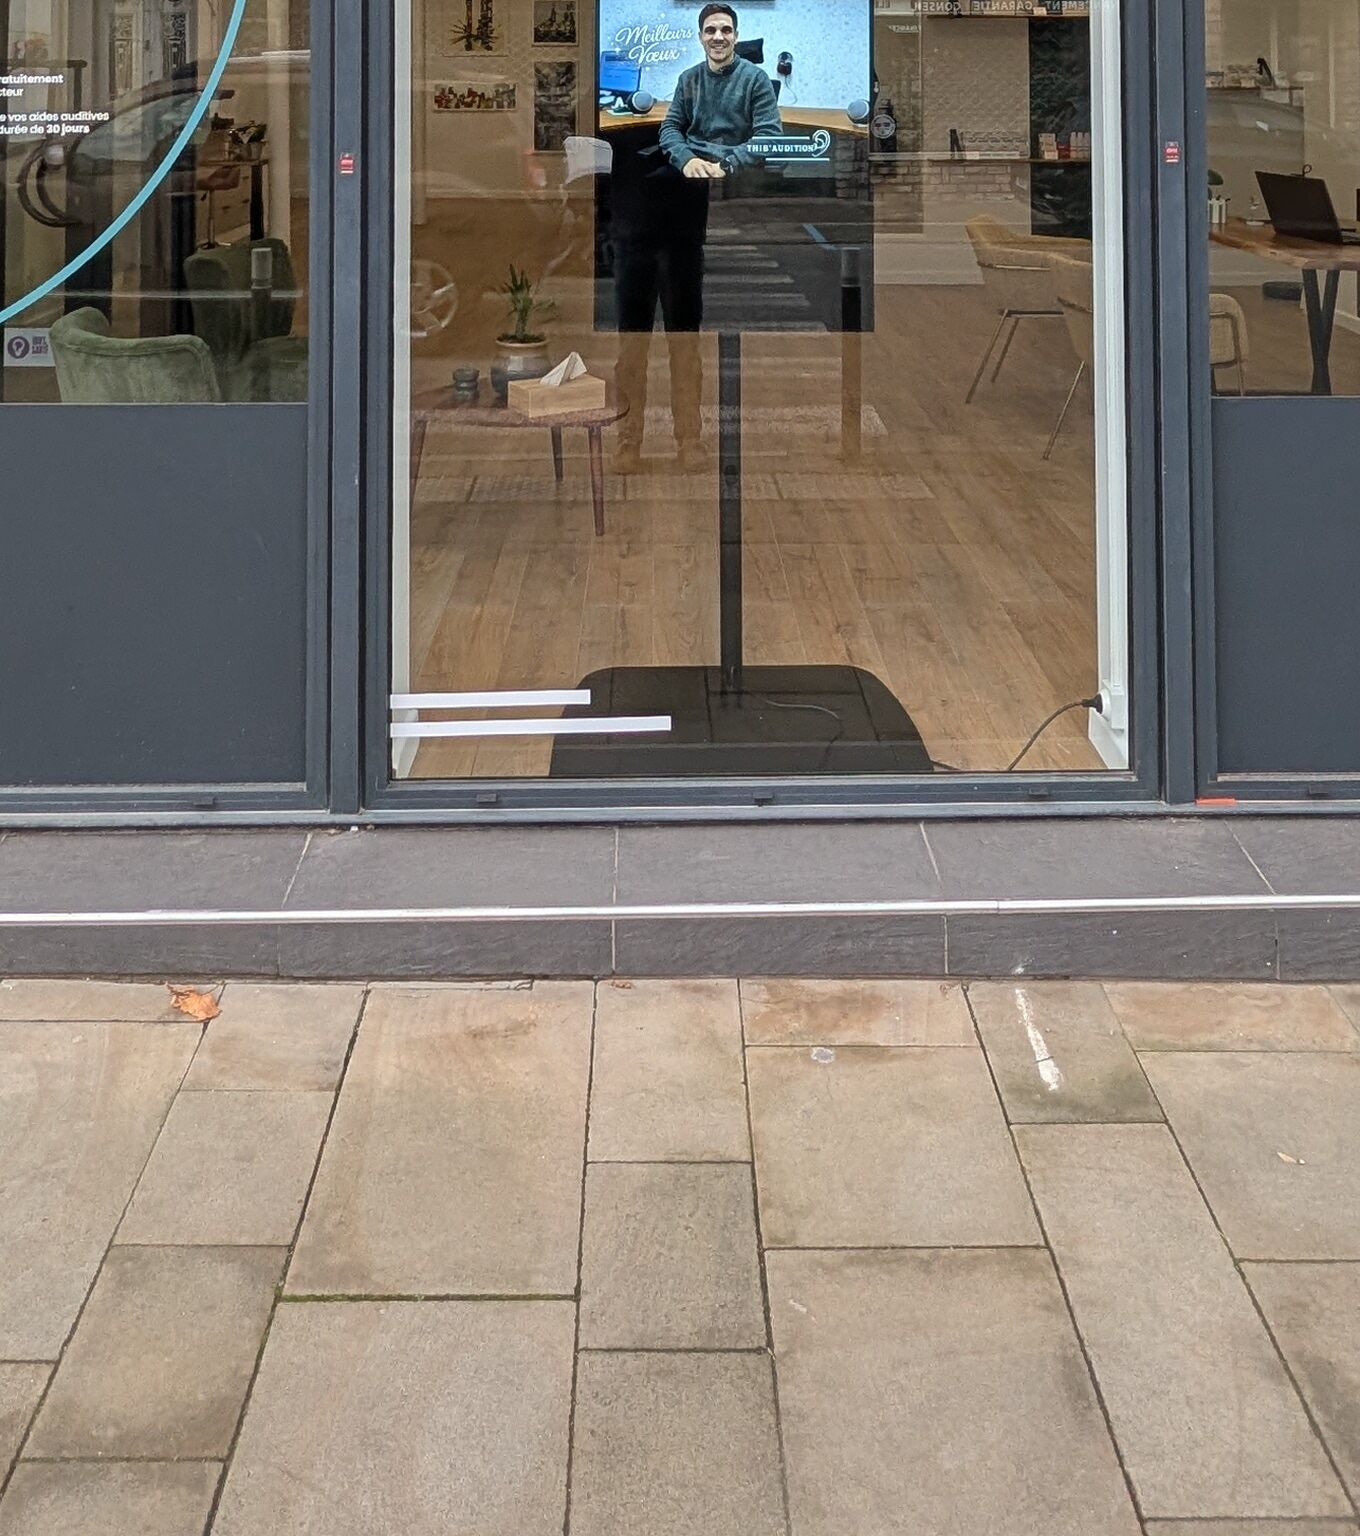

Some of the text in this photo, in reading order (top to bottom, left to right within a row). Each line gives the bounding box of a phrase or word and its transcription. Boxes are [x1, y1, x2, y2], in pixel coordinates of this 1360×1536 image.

[615, 24, 694, 47] Meilleurs
[7, 113, 28, 122] vos
[28, 112, 58, 121] aides
[60, 111, 110, 121] auditives
[30, 124, 44, 134] de
[61, 123, 90, 136] jours
